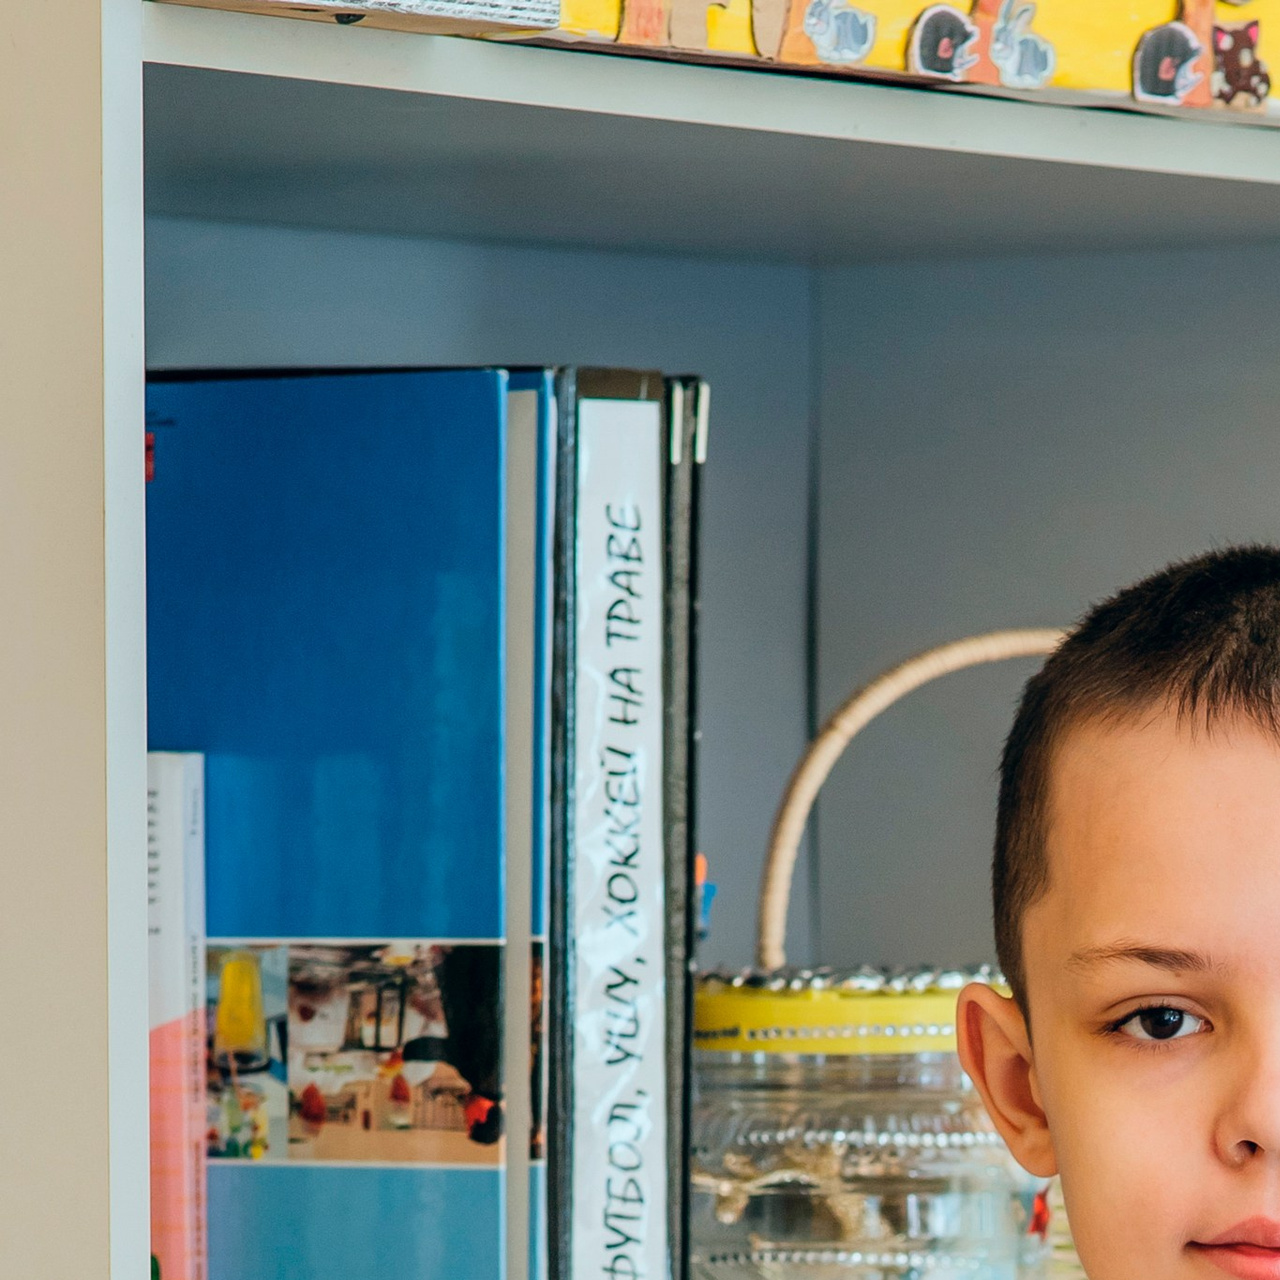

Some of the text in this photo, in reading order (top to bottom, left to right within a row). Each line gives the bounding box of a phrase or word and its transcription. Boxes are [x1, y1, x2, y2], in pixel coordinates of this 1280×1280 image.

[605, 503, 643, 648] ТРАВЕ
[606, 666, 643, 727] НА
[600, 745, 641, 937] ХОККЕЙ
[604, 956, 646, 1067] УШУ,
